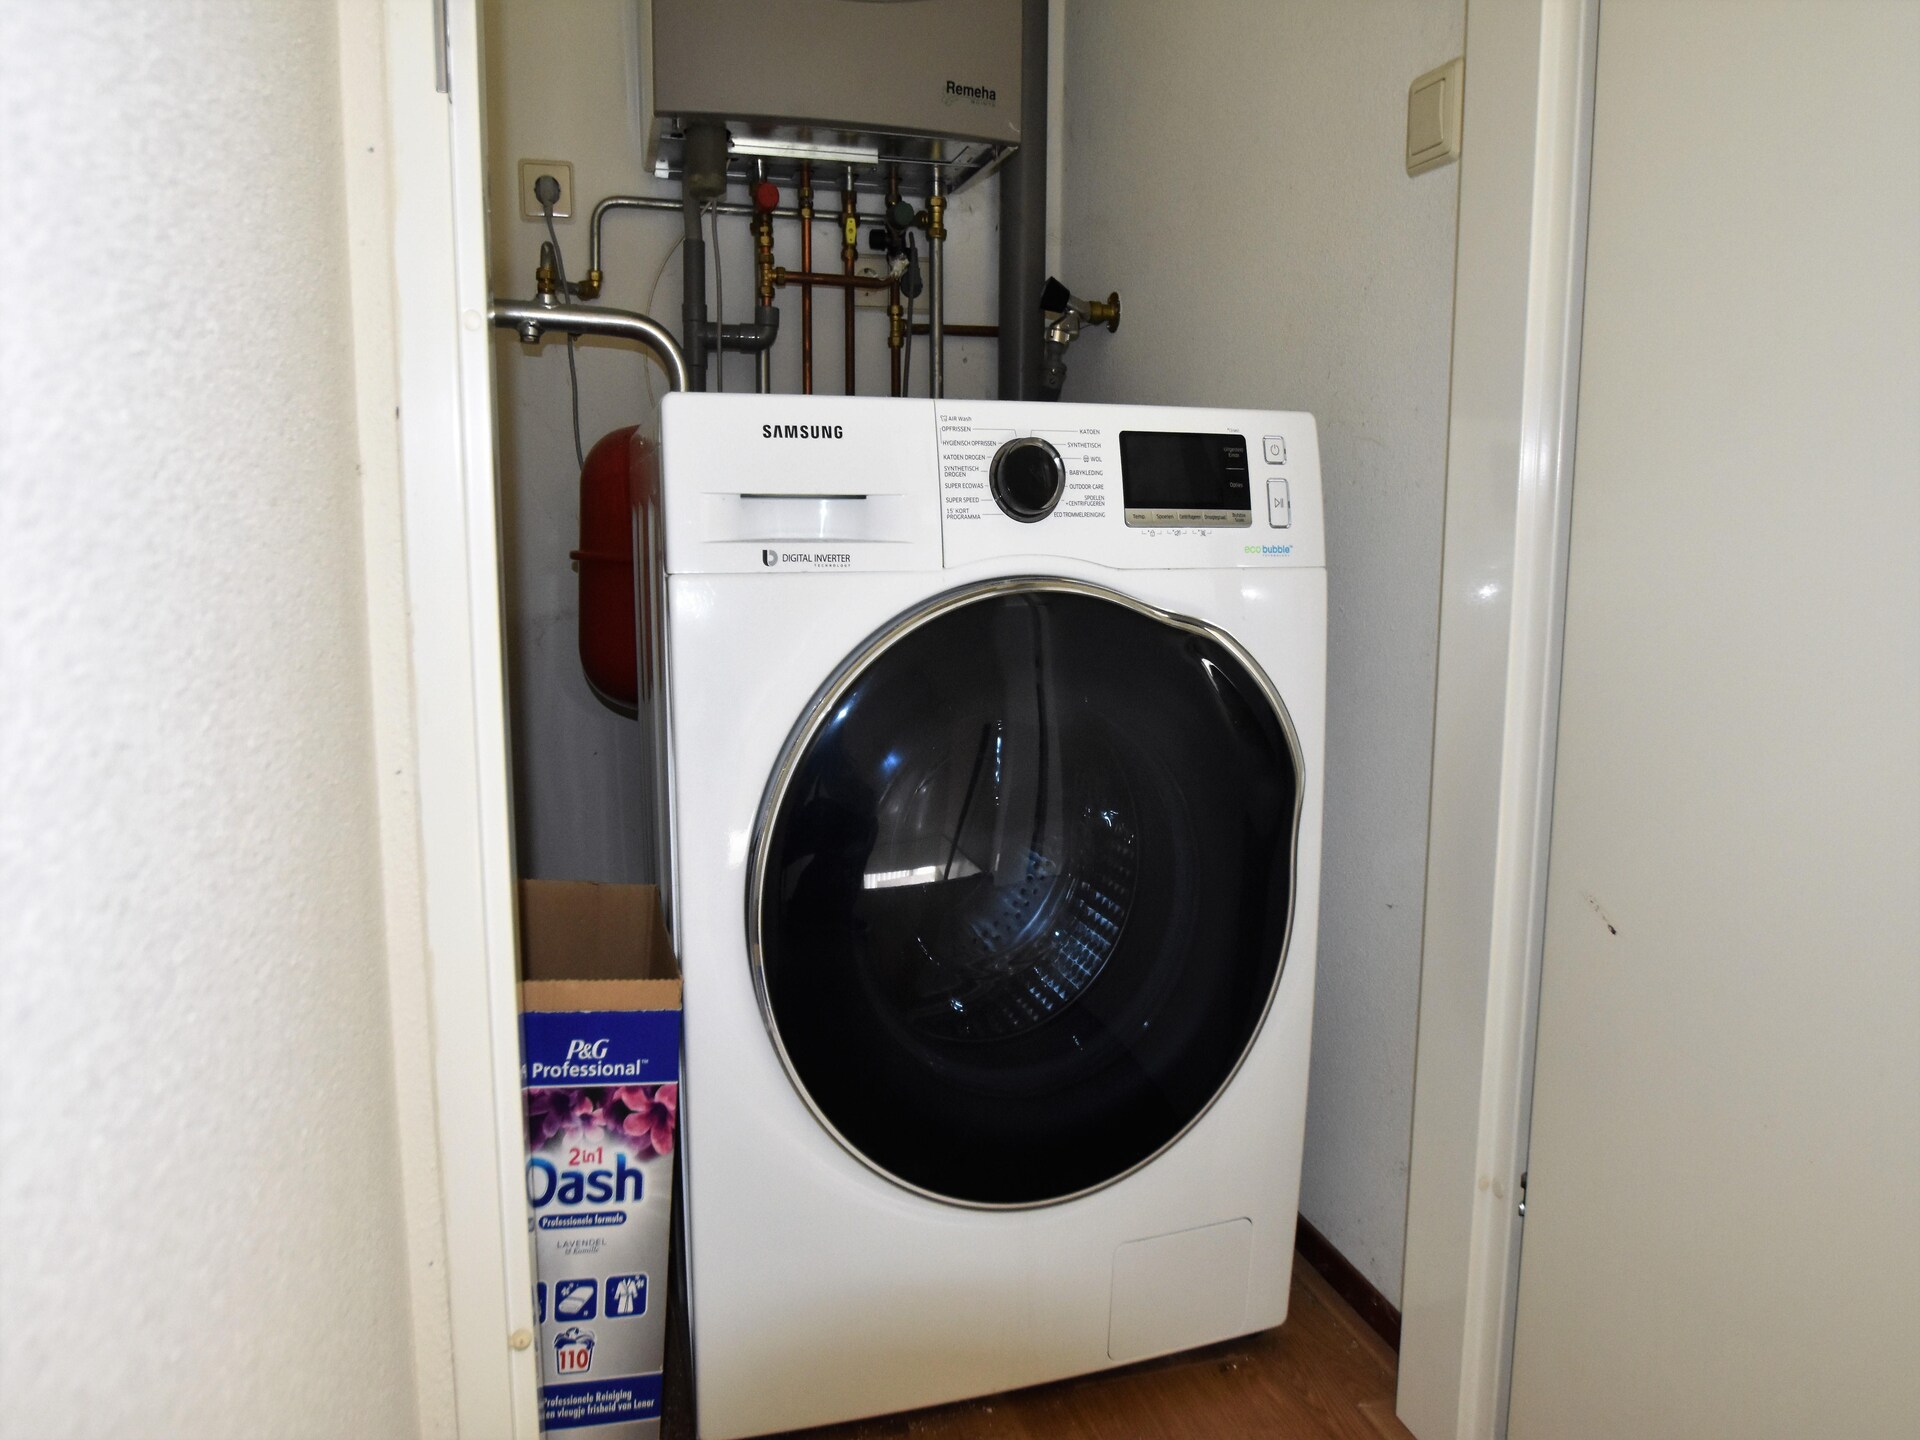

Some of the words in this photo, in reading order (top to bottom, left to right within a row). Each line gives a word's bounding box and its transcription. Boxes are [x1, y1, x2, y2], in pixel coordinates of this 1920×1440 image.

[946, 81, 996, 101] Remeha
[762, 424, 843, 439] SAMSUNG
[782, 553, 812, 562] DIGITAL
[814, 554, 851, 562] INVERTER
[1244, 546, 1261, 554] eco
[566, 1038, 610, 1060] P&G
[543, 1215, 593, 1228] Professionele
[594, 1212, 624, 1225] formule
[557, 1238, 608, 1249] LAVENDEL
[559, 1349, 589, 1371] 110
[596, 1389, 632, 1403] Reiniging
[557, 1405, 585, 1419] vleugje
[587, 1401, 616, 1415] frisheid
[618, 1402, 632, 1412] van
[633, 1398, 655, 1409] Lenor
